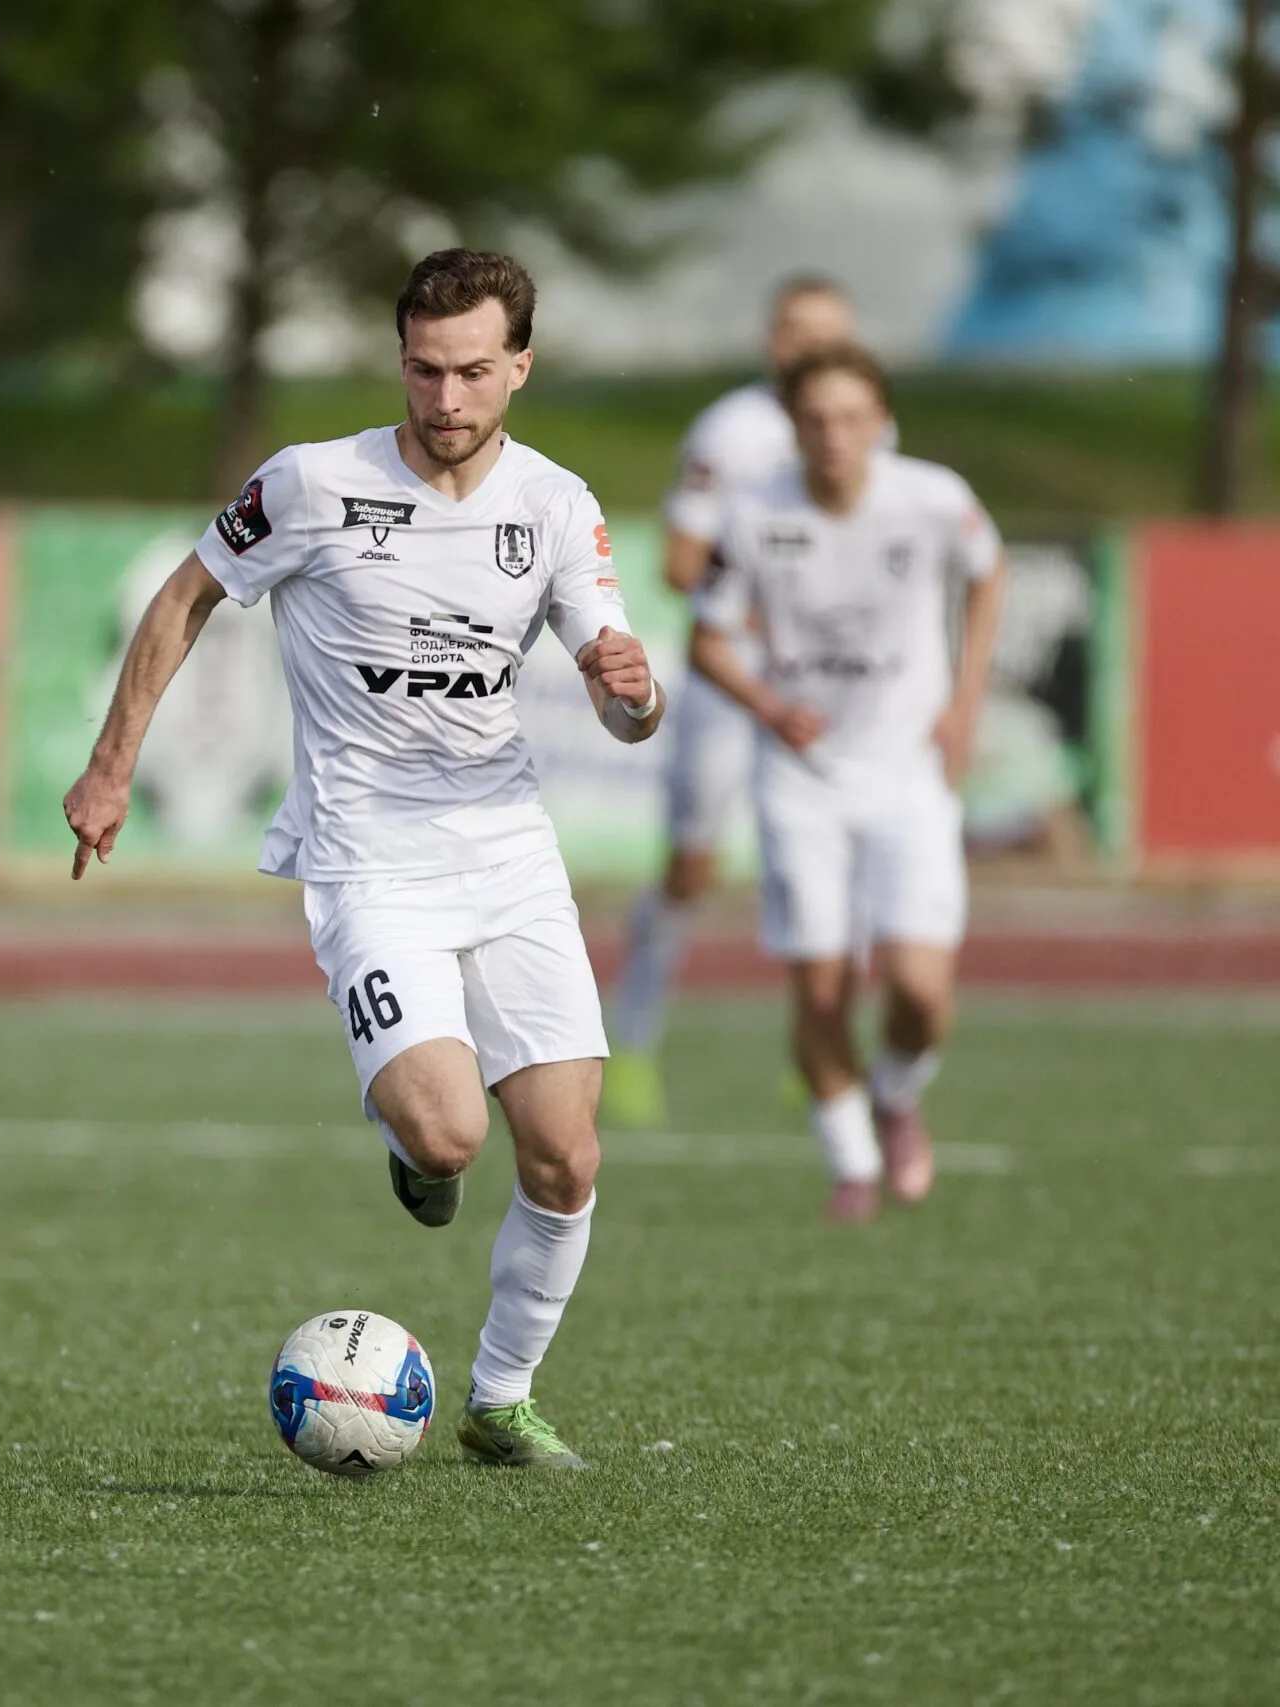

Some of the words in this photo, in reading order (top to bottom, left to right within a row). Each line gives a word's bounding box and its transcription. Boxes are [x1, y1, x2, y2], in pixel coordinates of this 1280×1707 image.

[350, 501, 405, 517] Заветный
[357, 512, 396, 523] родник
[356, 550, 400, 561] JÖGEL
[410, 640, 493, 651] ПОДДЕРЖКИ
[411, 653, 465, 664] СПОРТА
[355, 664, 512, 698] УРАЛ
[348, 969, 403, 1044] 46
[344, 1313, 369, 1366] DEMIX
